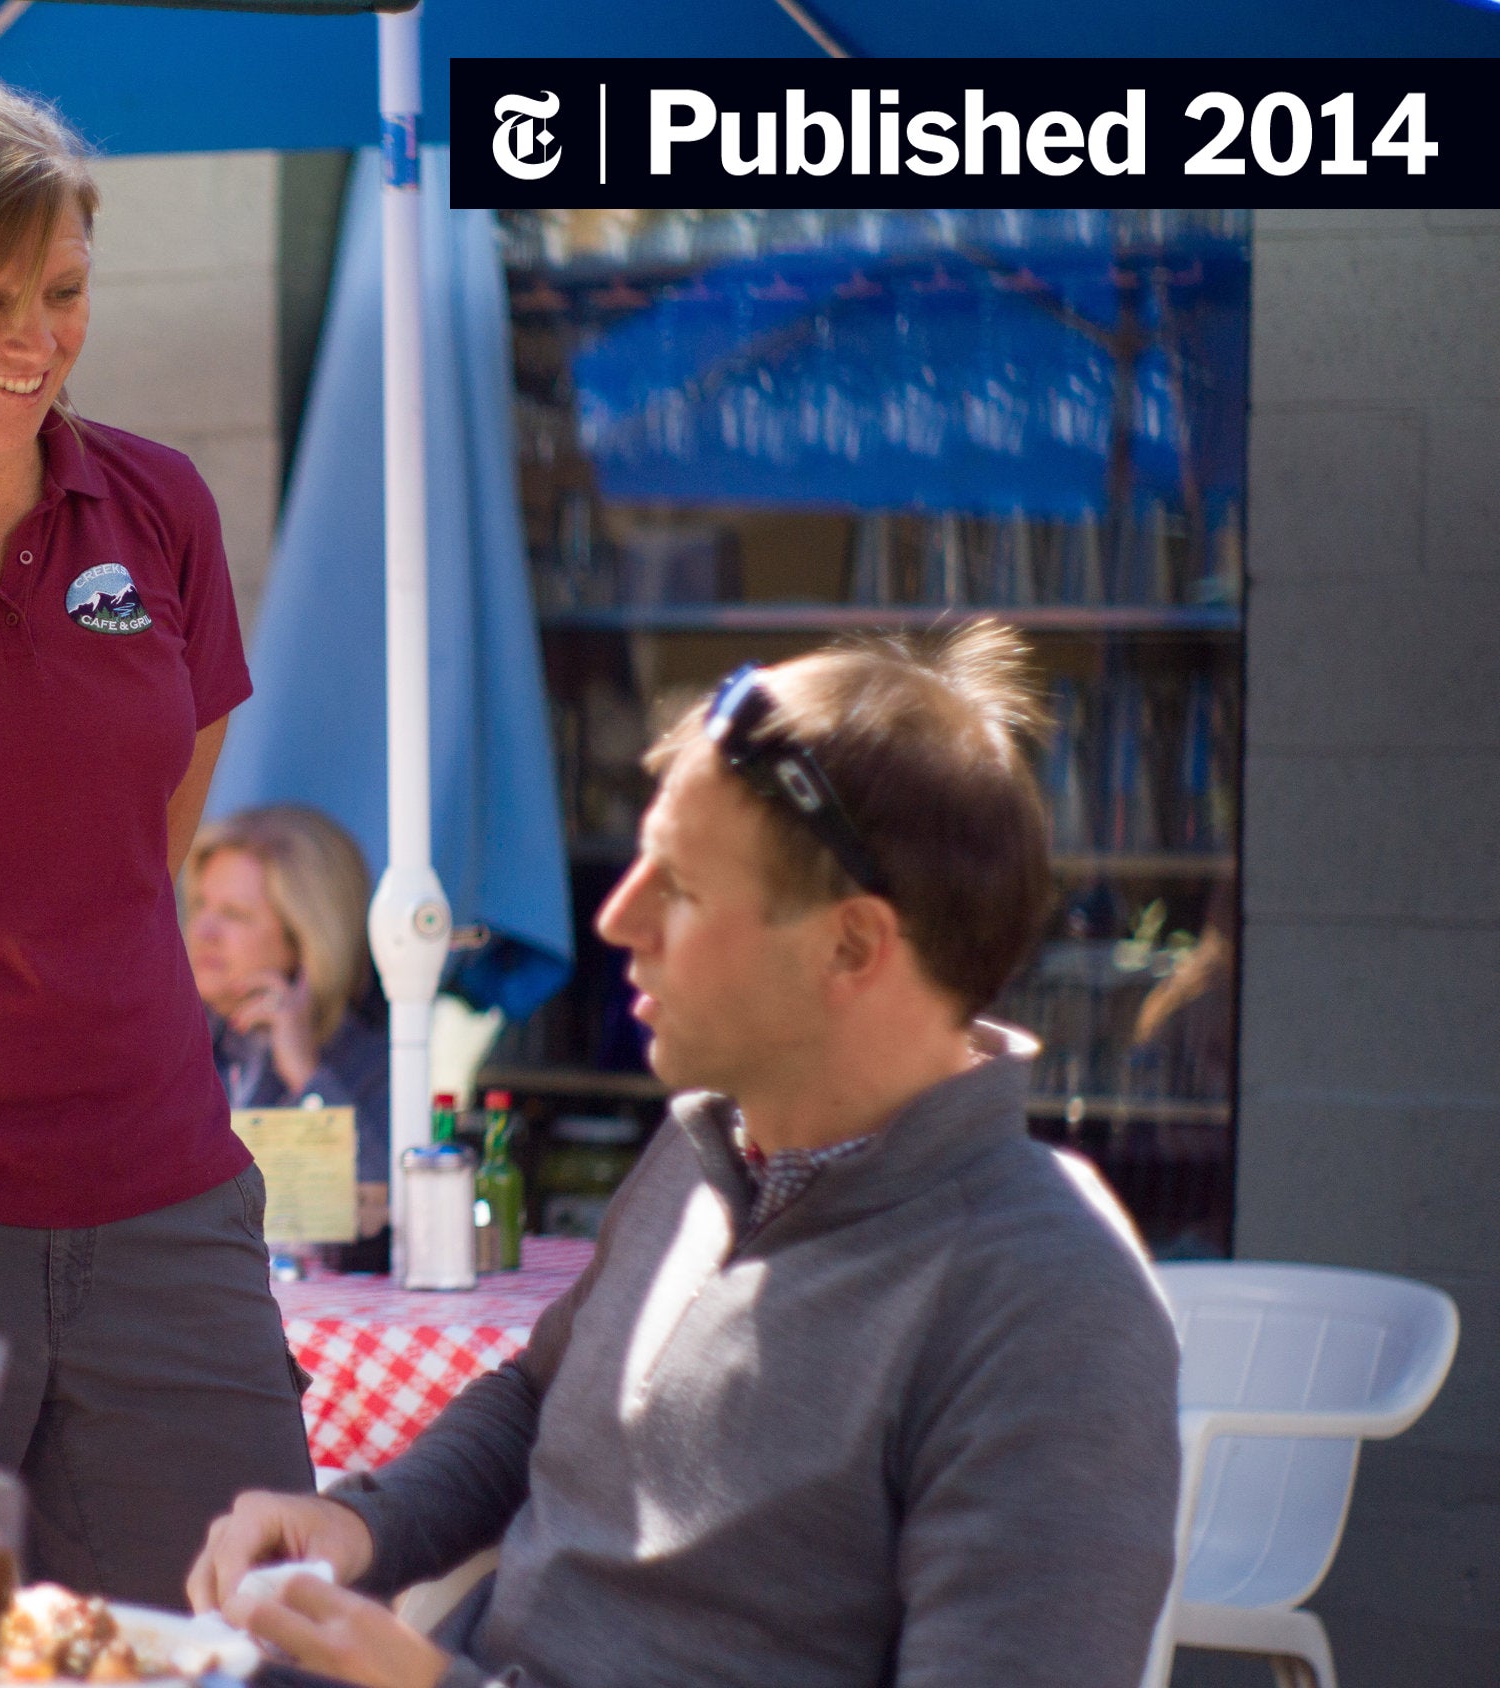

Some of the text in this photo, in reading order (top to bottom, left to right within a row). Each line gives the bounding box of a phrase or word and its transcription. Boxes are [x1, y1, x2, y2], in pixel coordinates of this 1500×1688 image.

[74, 564, 130, 588] CREEKS
[81, 615, 117, 631] CAFE
[119, 621, 129, 631] &
